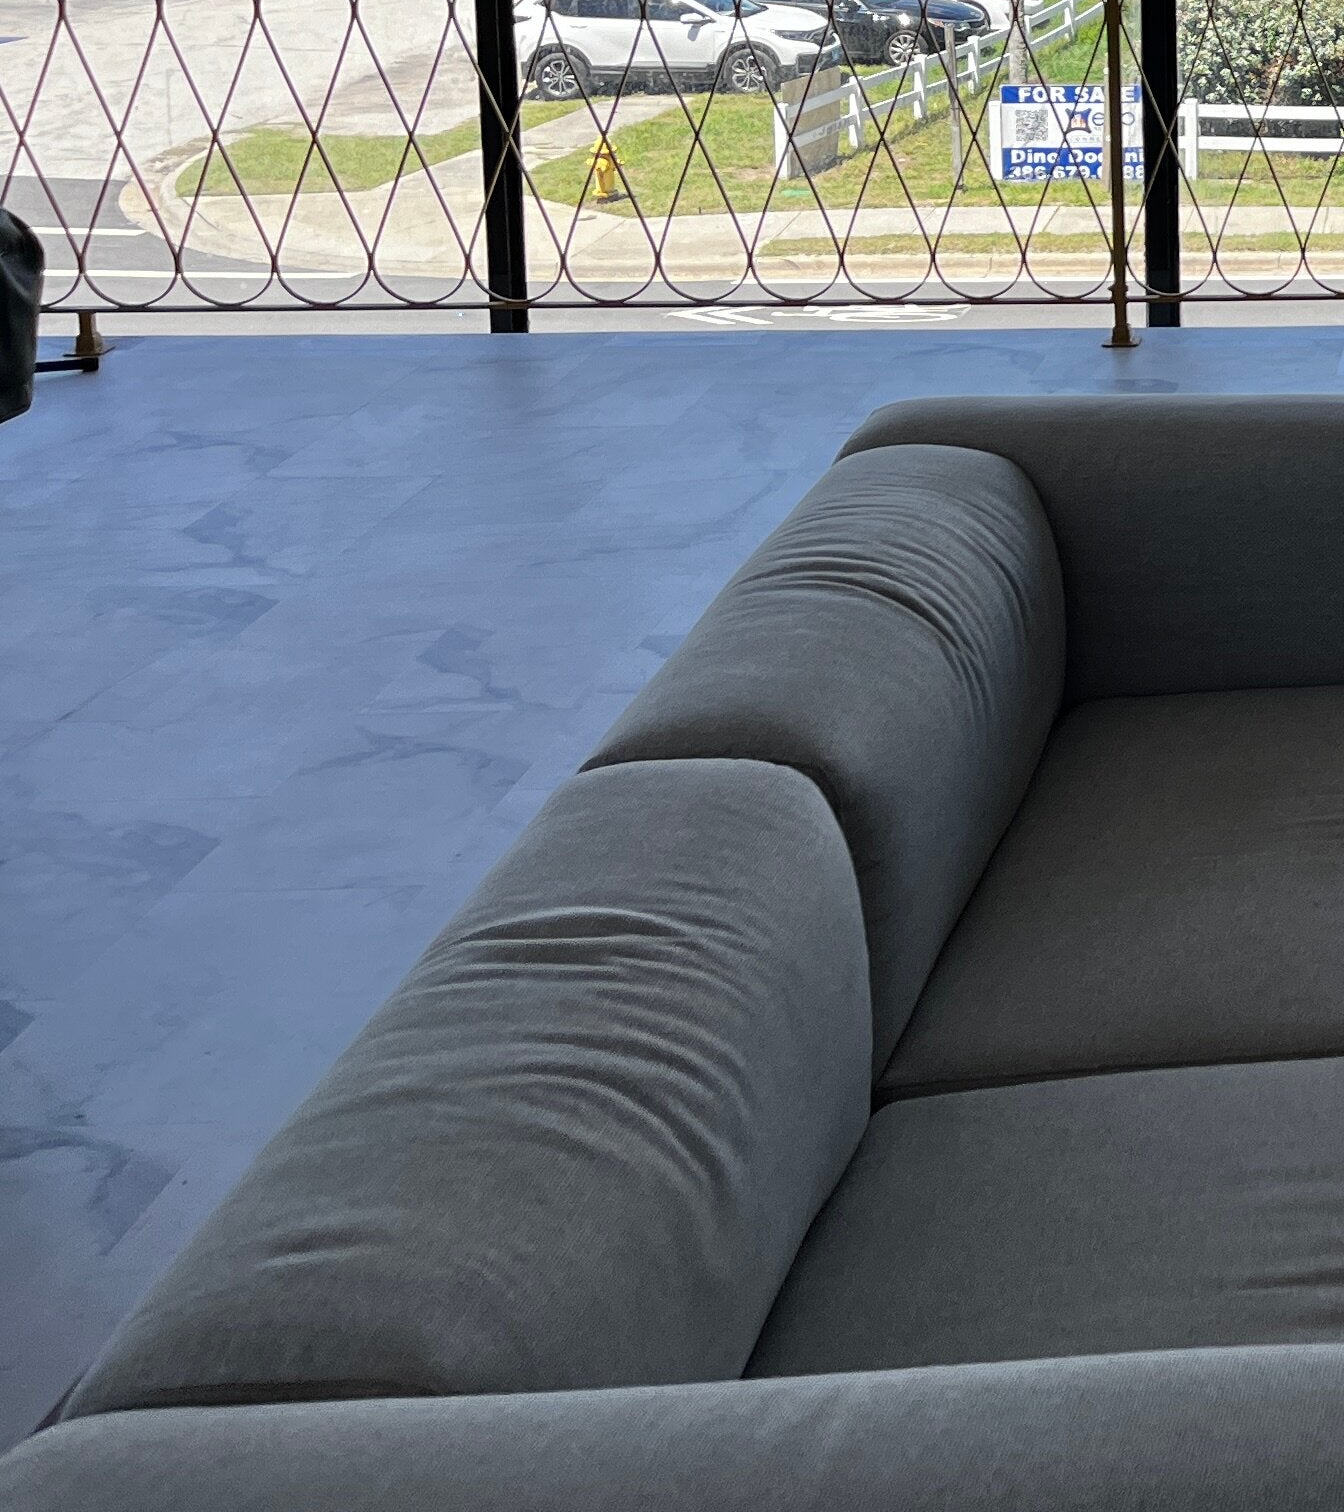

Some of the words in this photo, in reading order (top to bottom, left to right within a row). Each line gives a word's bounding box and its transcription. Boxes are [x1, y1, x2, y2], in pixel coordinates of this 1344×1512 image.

[1018, 86, 1066, 103] FOR
[1074, 86, 1135, 103] SAE
[1010, 148, 1058, 164] Dino
